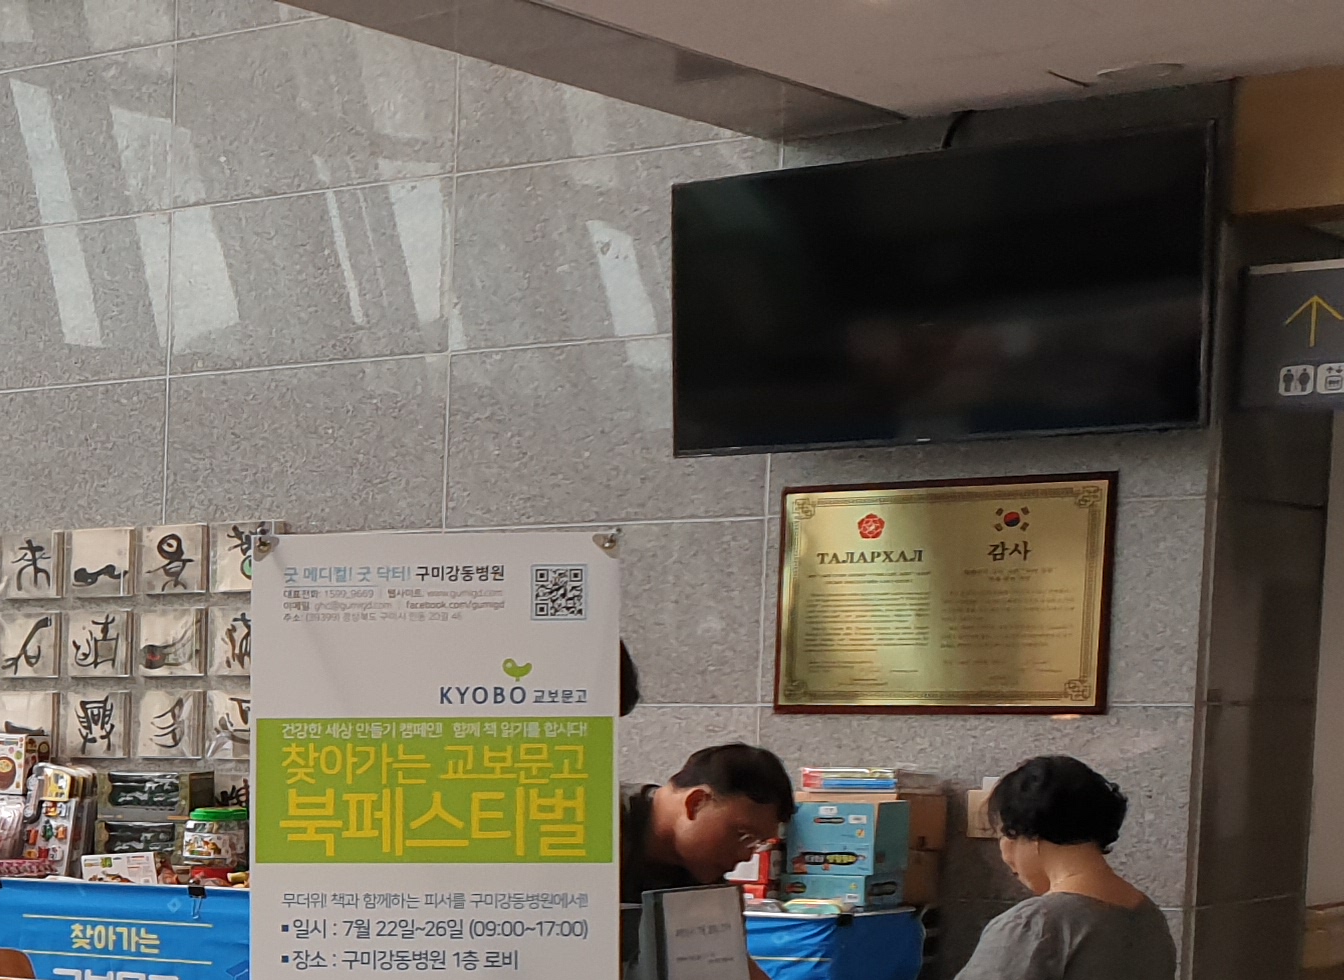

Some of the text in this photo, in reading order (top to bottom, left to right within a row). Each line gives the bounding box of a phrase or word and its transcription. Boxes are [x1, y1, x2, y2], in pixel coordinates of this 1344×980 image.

[816, 549, 924, 565] ТАЛАРХАЛ
[987, 540, 1032, 562] 감사
[283, 564, 505, 583] 굿 메디컬! 굿 닥터! 구미강동병원
[439, 686, 588, 705] KYOBO 교보문고
[281, 722, 322, 739] 건강한
[325, 722, 353, 739] 세상
[356, 722, 397, 739] 만들기
[453, 721, 481, 739] 함께
[483, 721, 497, 738] 책
[500, 721, 541, 739] 읽기를
[280, 742, 589, 786] 찾아가는 교보문고
[278, 786, 588, 858] 북페스티벌
[282, 891, 328, 909] 무더위!
[330, 891, 360, 909] 책과
[363, 891, 421, 910] 함께하는
[424, 892, 467, 910] 피서를
[70, 922, 161, 955] 찾아가는
[292, 919, 327, 939] 일시
[342, 919, 371, 939] 7월
[375, 919, 464, 939] 22일~26일
[469, 919, 589, 940] (09:00~17:00)
[292, 950, 328, 970] 장소
[341, 949, 447, 970] 구미강동병원
[453, 950, 480, 970] 1층
[483, 950, 520, 971] 로비
